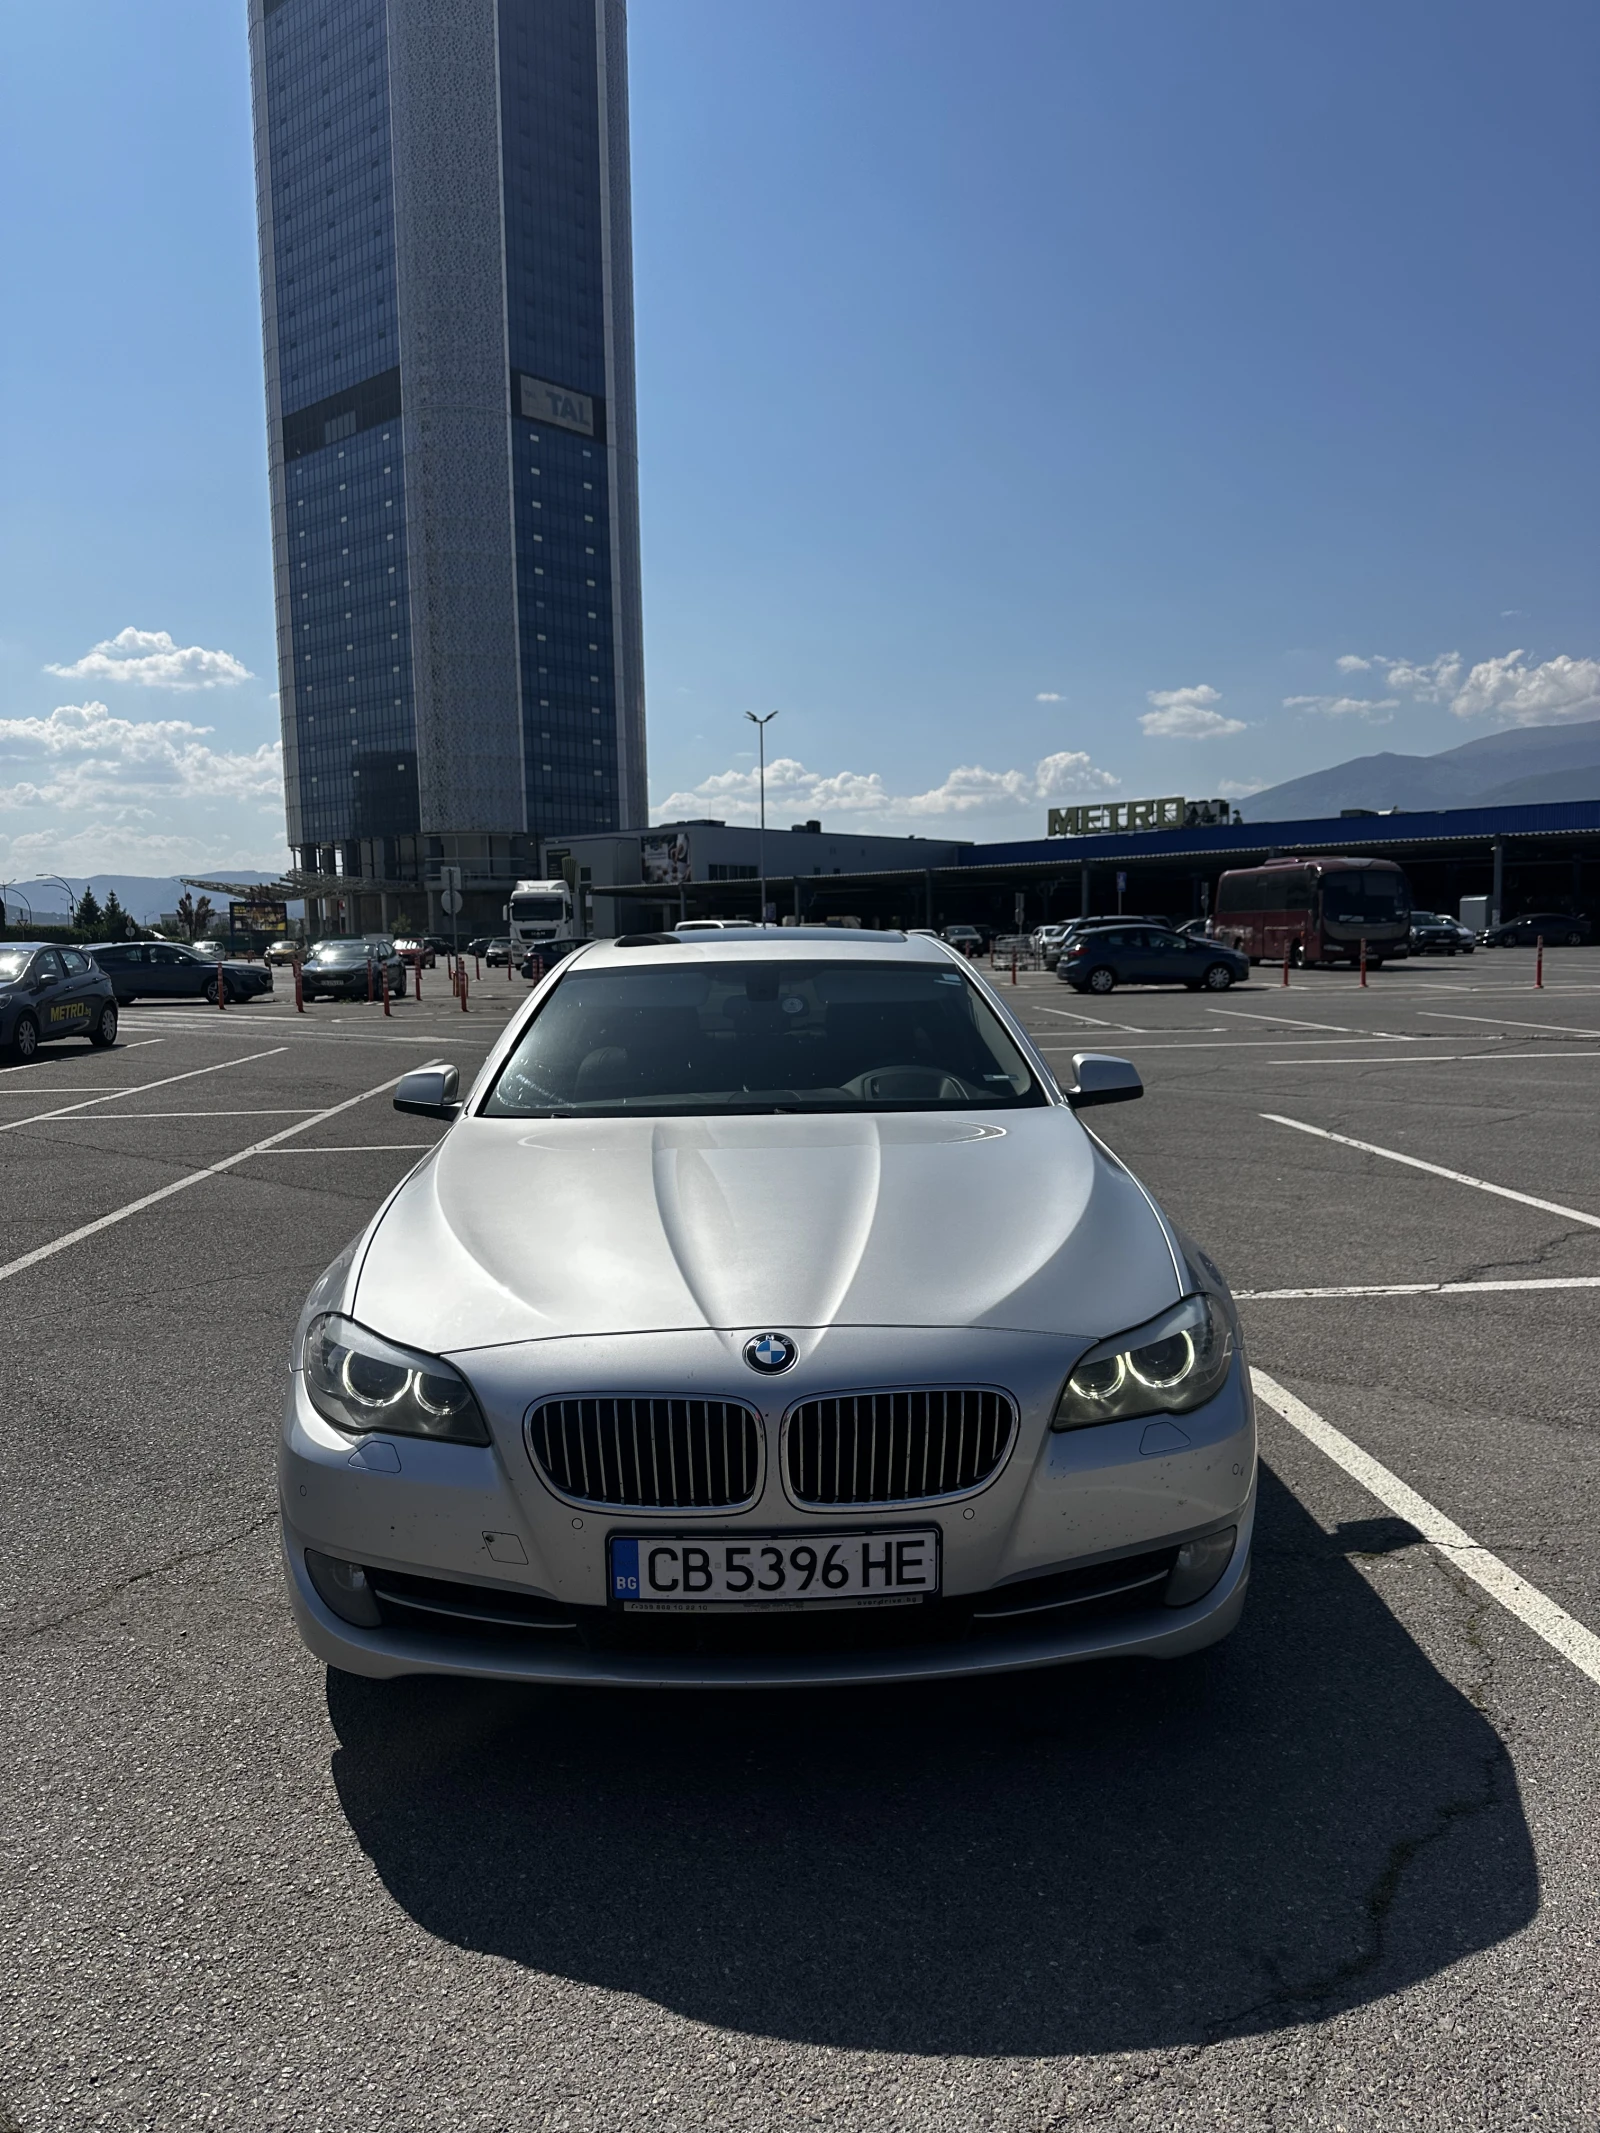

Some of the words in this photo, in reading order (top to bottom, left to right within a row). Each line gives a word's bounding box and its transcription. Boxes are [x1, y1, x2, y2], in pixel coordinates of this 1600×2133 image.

[545, 390, 591, 427] TAL
[1048, 797, 1185, 836] METRO
[616, 1576, 638, 1590] BG
[648, 1547, 713, 1592] CB
[726, 1544, 849, 1593] 5396
[862, 1539, 927, 1588] HE
